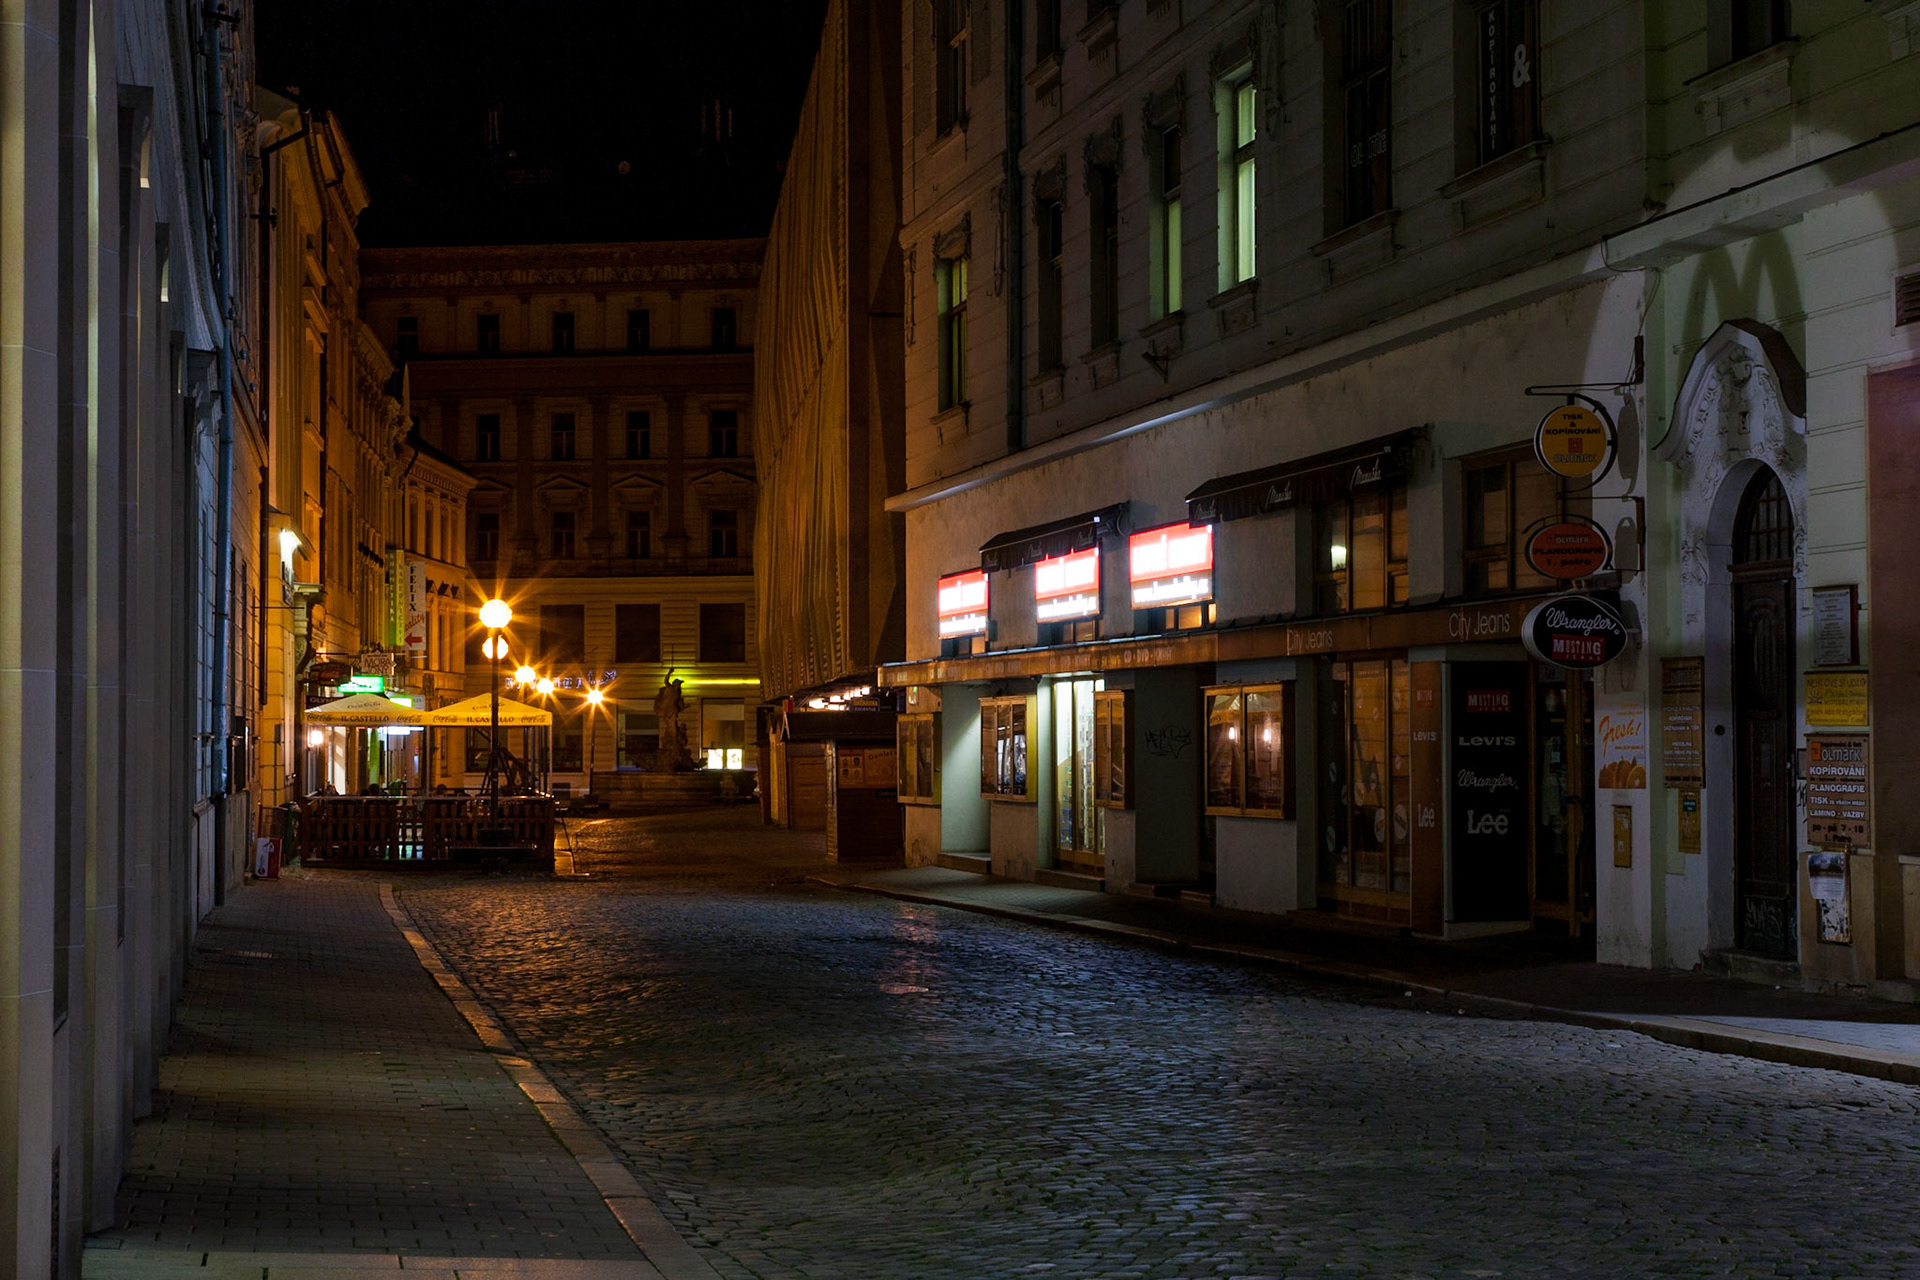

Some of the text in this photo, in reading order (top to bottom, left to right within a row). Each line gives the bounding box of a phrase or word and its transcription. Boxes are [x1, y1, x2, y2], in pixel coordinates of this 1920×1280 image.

[1512, 43, 1531, 88] &
[1545, 426, 1601, 436] KOPÍROVÁNÍ
[1561, 557, 1592, 567] patro
[409, 566, 417, 612] FELIX
[1449, 611, 1510, 641] City Jeans
[1546, 607, 1617, 636] Wrangler
[1288, 629, 1333, 653] City Jeans
[1552, 638, 1602, 655] MUSTANG
[1468, 694, 1509, 706] MUSTANG
[1598, 714, 1642, 757] Fresh!
[1809, 764, 1866, 776] KOPÍROVÁNÍ
[1458, 768, 1519, 793] Wrangler
[1809, 783, 1865, 793] PLANOGRAFIE
[1810, 796, 1829, 805] TISK
[1417, 803, 1435, 827] Lee
[1467, 808, 1509, 835] Lee
[1809, 809, 1837, 818] LAMINO
[1842, 810, 1865, 818] VAZBY
[1812, 824, 1822, 833] po
[1841, 824, 1846, 832] 7
[1824, 834, 1852, 843] 1. Patro
